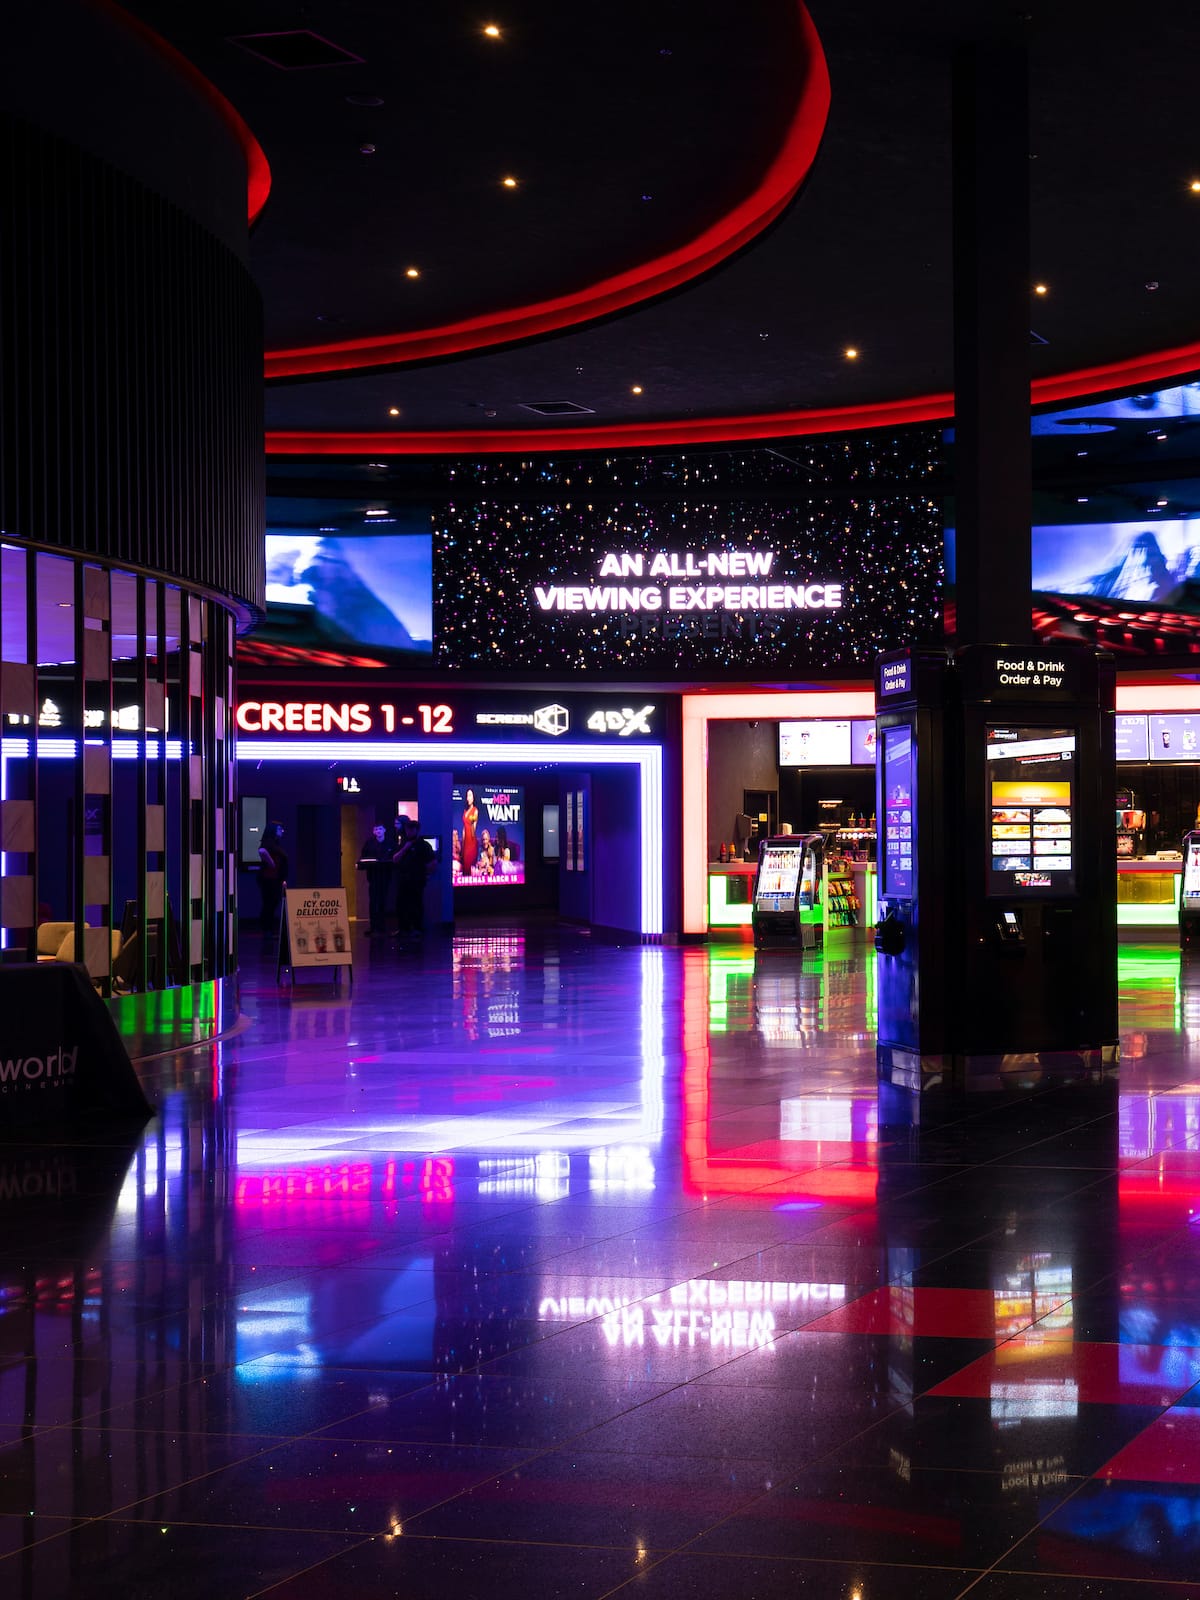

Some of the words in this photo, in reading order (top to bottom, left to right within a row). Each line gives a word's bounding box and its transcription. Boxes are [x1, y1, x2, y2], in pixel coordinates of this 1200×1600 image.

[600, 553, 643, 576] AN
[650, 552, 773, 576] ALL-NEW
[534, 586, 662, 610] VIEWING
[669, 585, 842, 610] EXPERIENCE
[996, 660, 1025, 671] Food
[1026, 661, 1035, 671] &
[1037, 661, 1065, 672] Drink
[1000, 674, 1031, 685] Order
[1032, 675, 1041, 685] &
[1043, 675, 1062, 687] Pay
[236, 701, 372, 733] CREENS
[493, 793, 510, 805] MEN
[487, 804, 521, 821] WANT
[488, 875, 509, 883] MARCH
[296, 907, 339, 916] DELICIOUS
